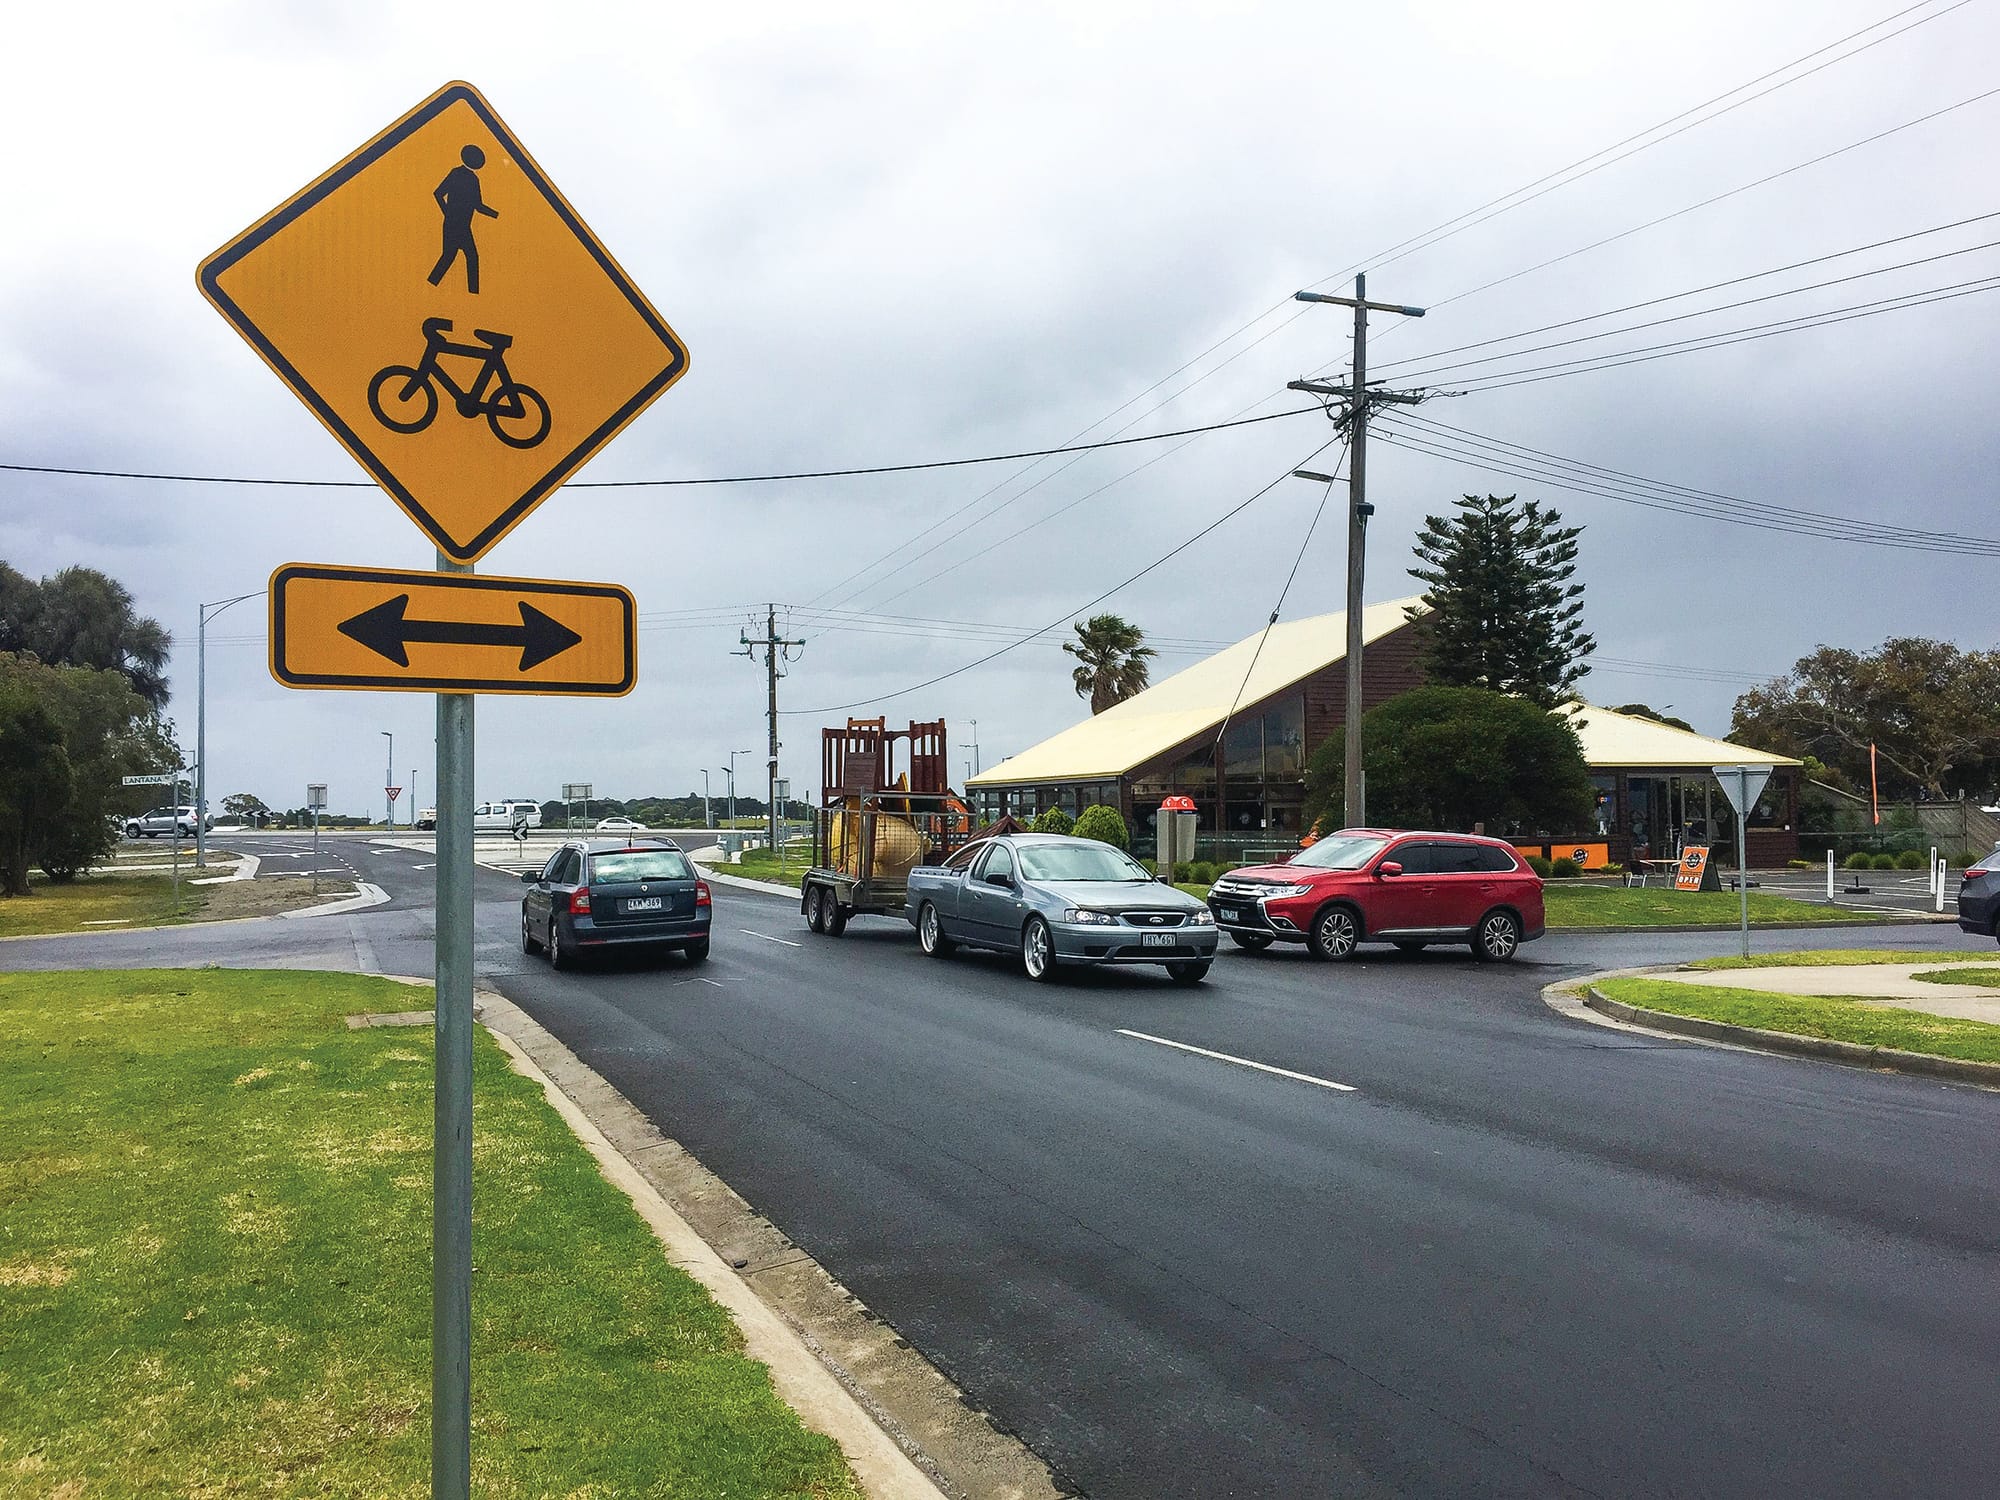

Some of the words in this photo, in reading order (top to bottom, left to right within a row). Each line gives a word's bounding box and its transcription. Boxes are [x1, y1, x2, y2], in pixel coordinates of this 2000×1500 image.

[124, 776, 162, 784] LANTANA
[1678, 876, 1700, 884] OPEN
[646, 898, 660, 907] 369
